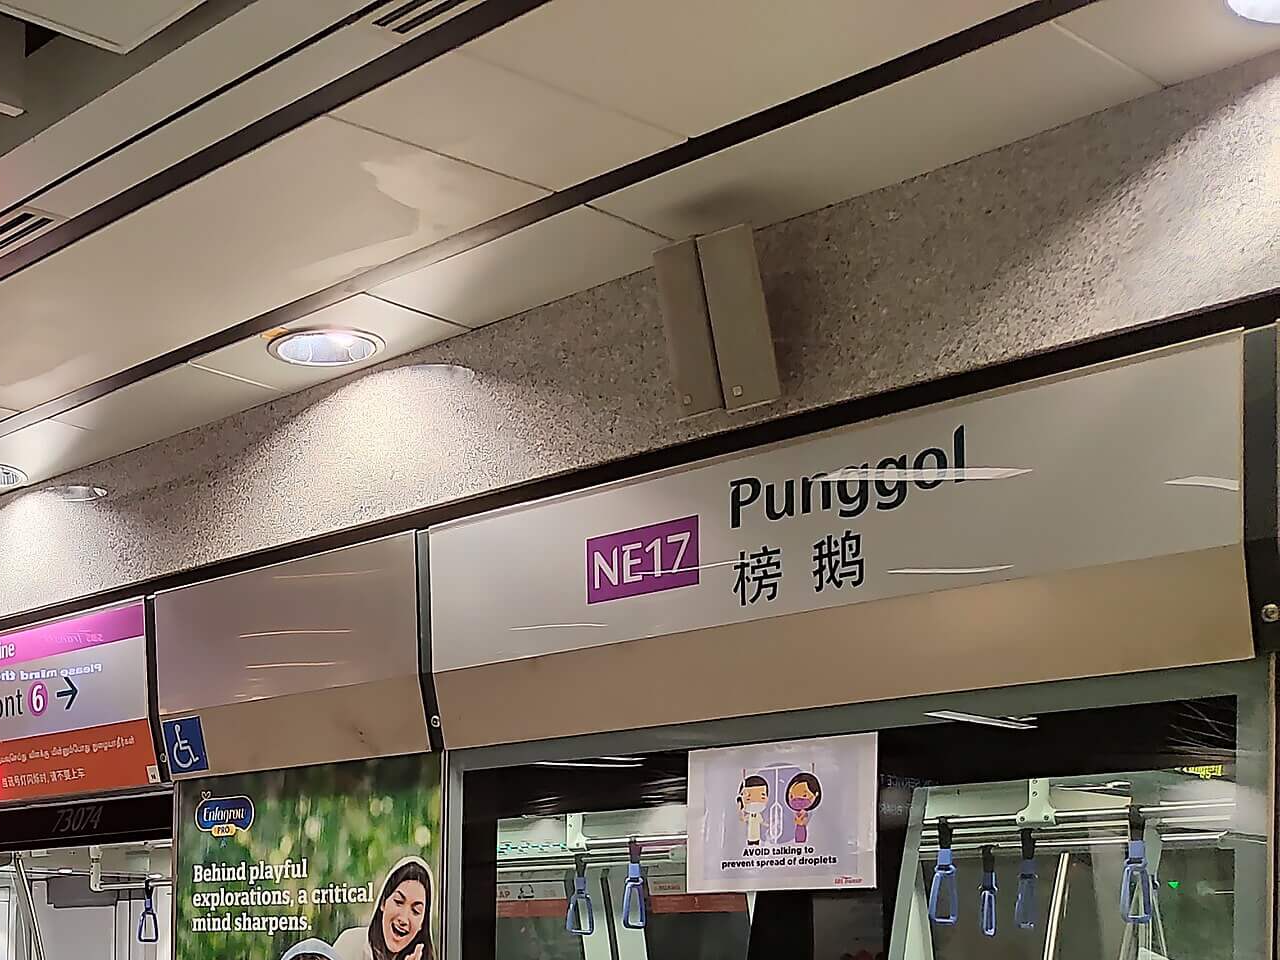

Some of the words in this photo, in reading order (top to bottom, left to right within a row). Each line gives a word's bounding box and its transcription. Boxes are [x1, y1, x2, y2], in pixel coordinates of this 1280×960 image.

[729, 424, 967, 528] Punggol
[593, 531, 692, 590] NE17
[32, 684, 44, 713] 6
[52, 805, 104, 833] 73074
[217, 826, 230, 834] PRO
[722, 860, 755, 869] prevent
[756, 858, 786, 870] spread
[787, 857, 797, 866] of
[799, 855, 837, 868] droplets
[743, 848, 770, 857] AVOID
[772, 846, 802, 857] talking
[804, 846, 814, 854] to
[192, 861, 246, 883] Behind
[249, 858, 308, 884] playful
[192, 886, 294, 912] explorations,
[298, 891, 308, 904] a
[311, 882, 374, 904] critical
[192, 914, 232, 932] mind
[234, 912, 312, 935] sharpens.
